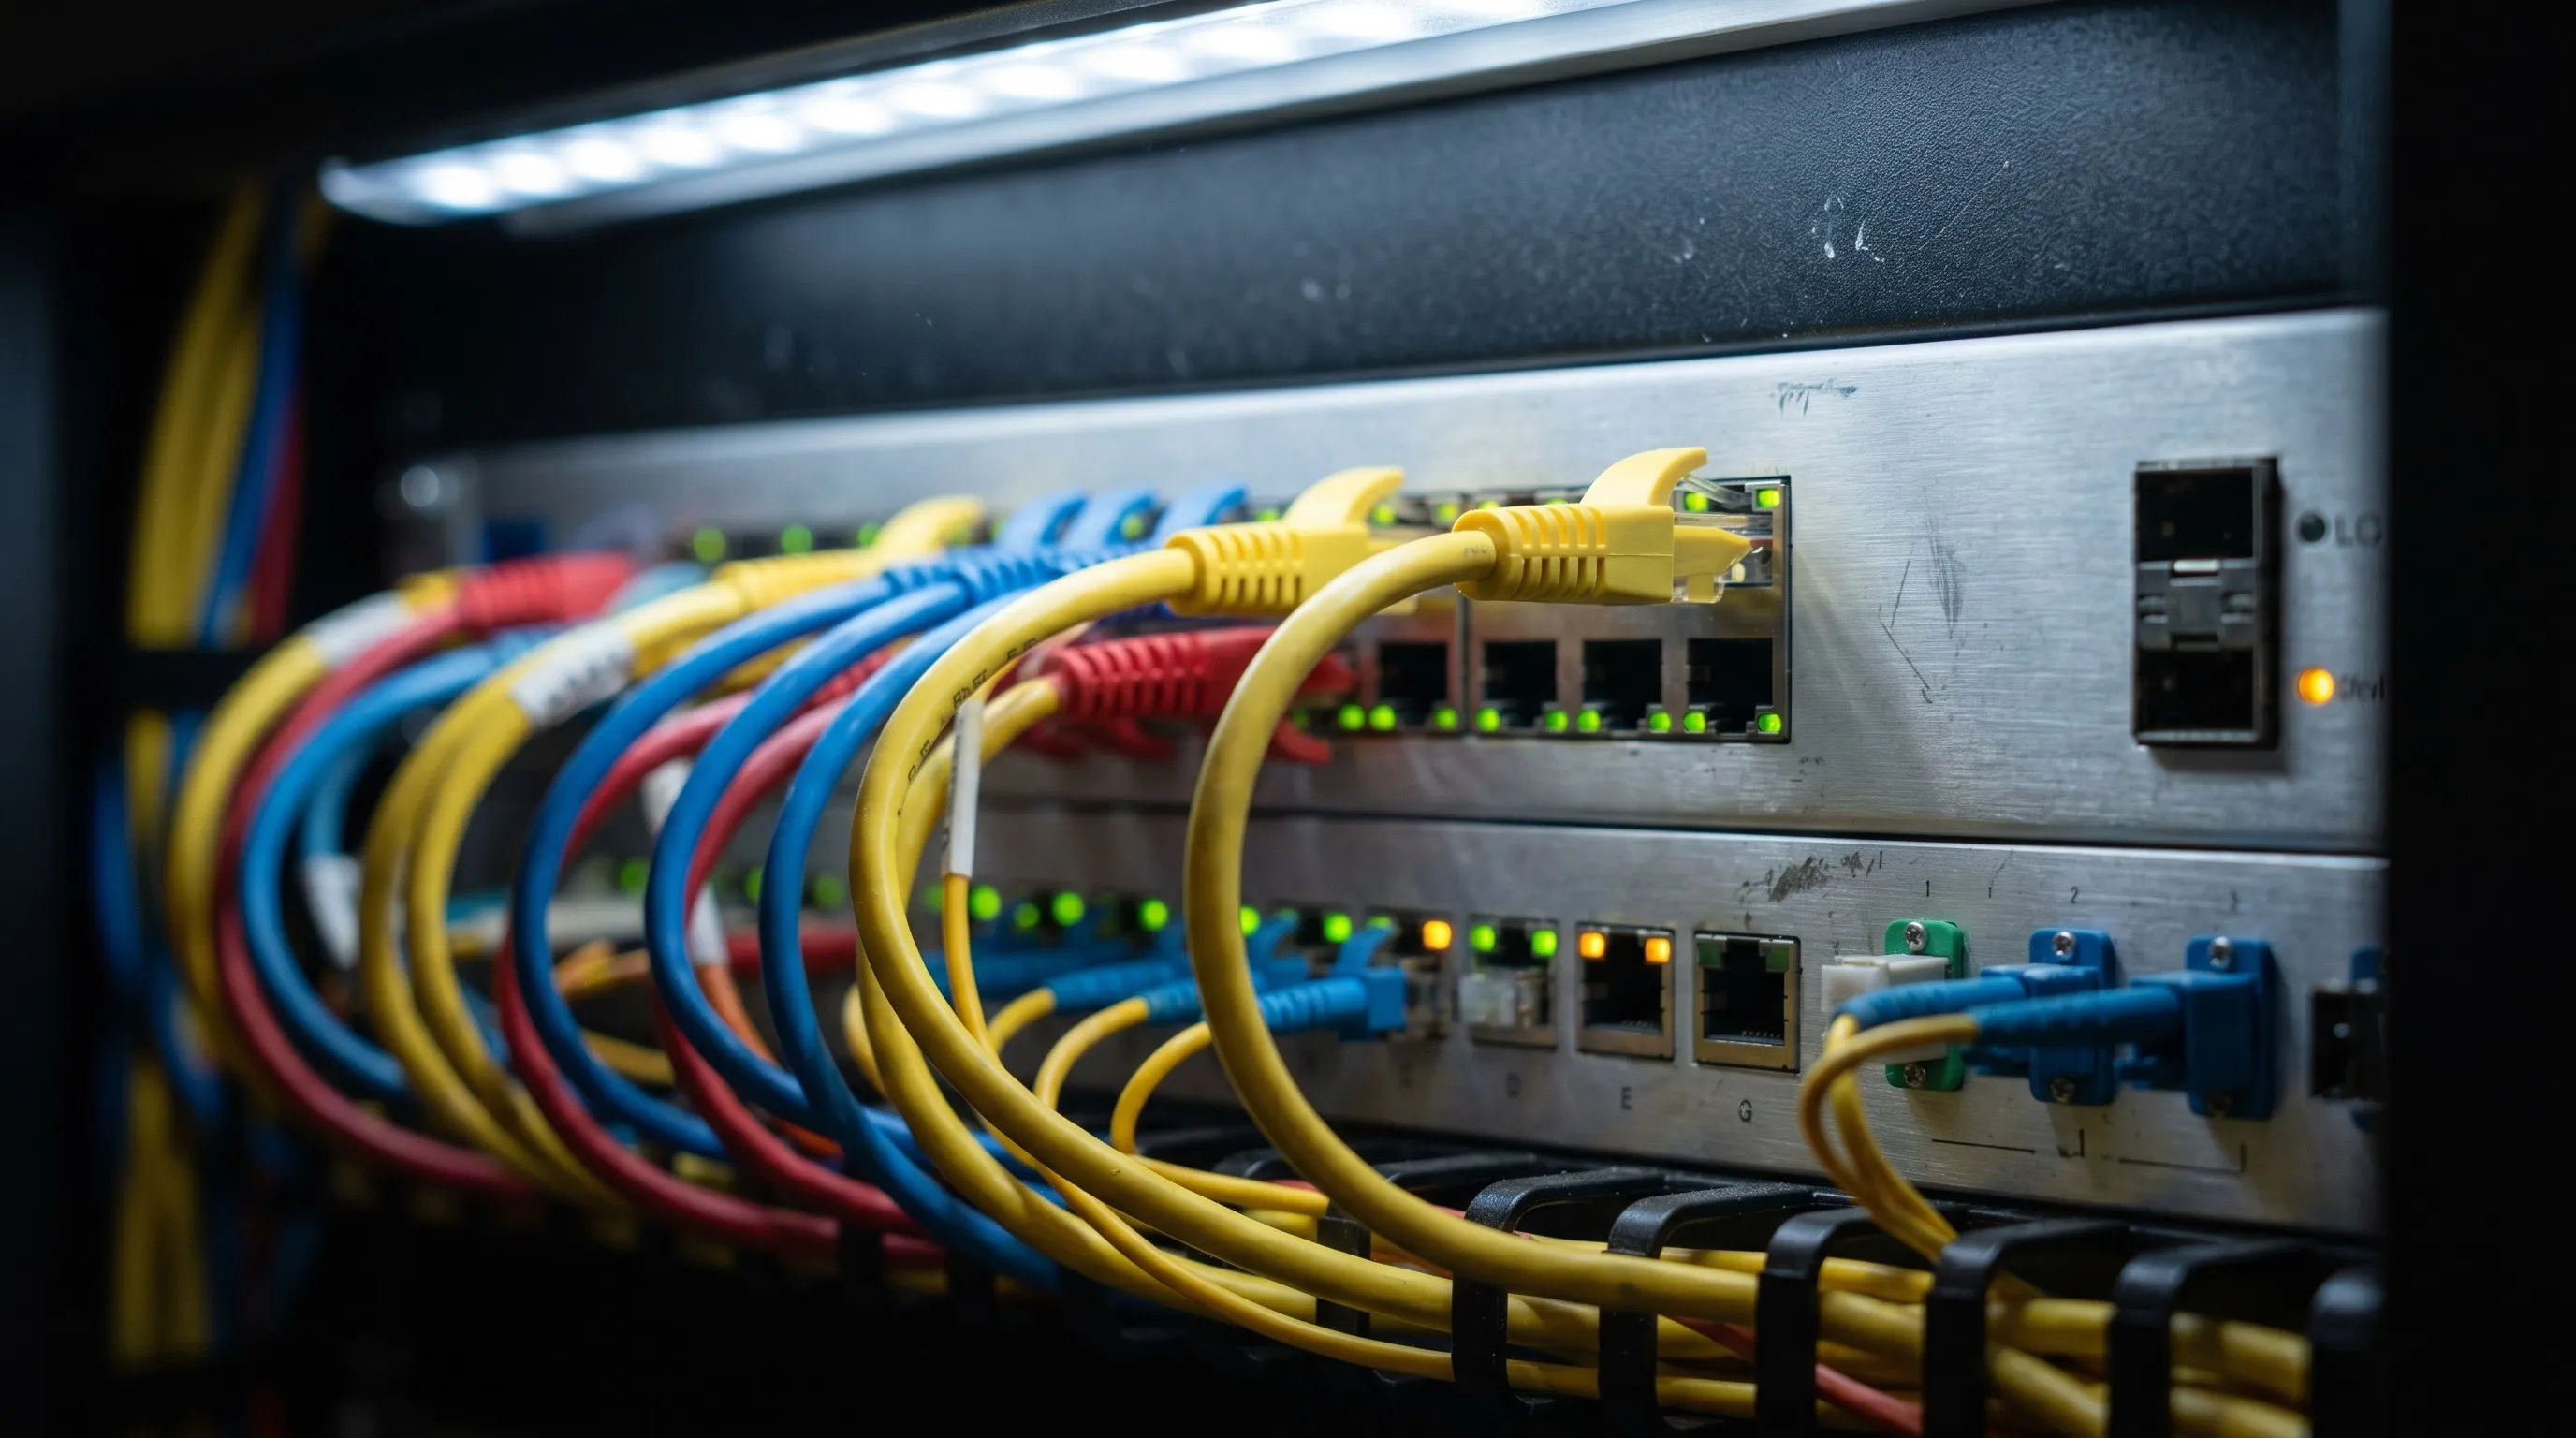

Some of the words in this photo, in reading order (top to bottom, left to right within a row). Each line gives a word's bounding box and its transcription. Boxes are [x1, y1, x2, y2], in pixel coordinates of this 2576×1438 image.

[2070, 886, 2080, 904] 2
[1620, 1086, 1633, 1110] E
[1738, 1099, 1752, 1123] G
